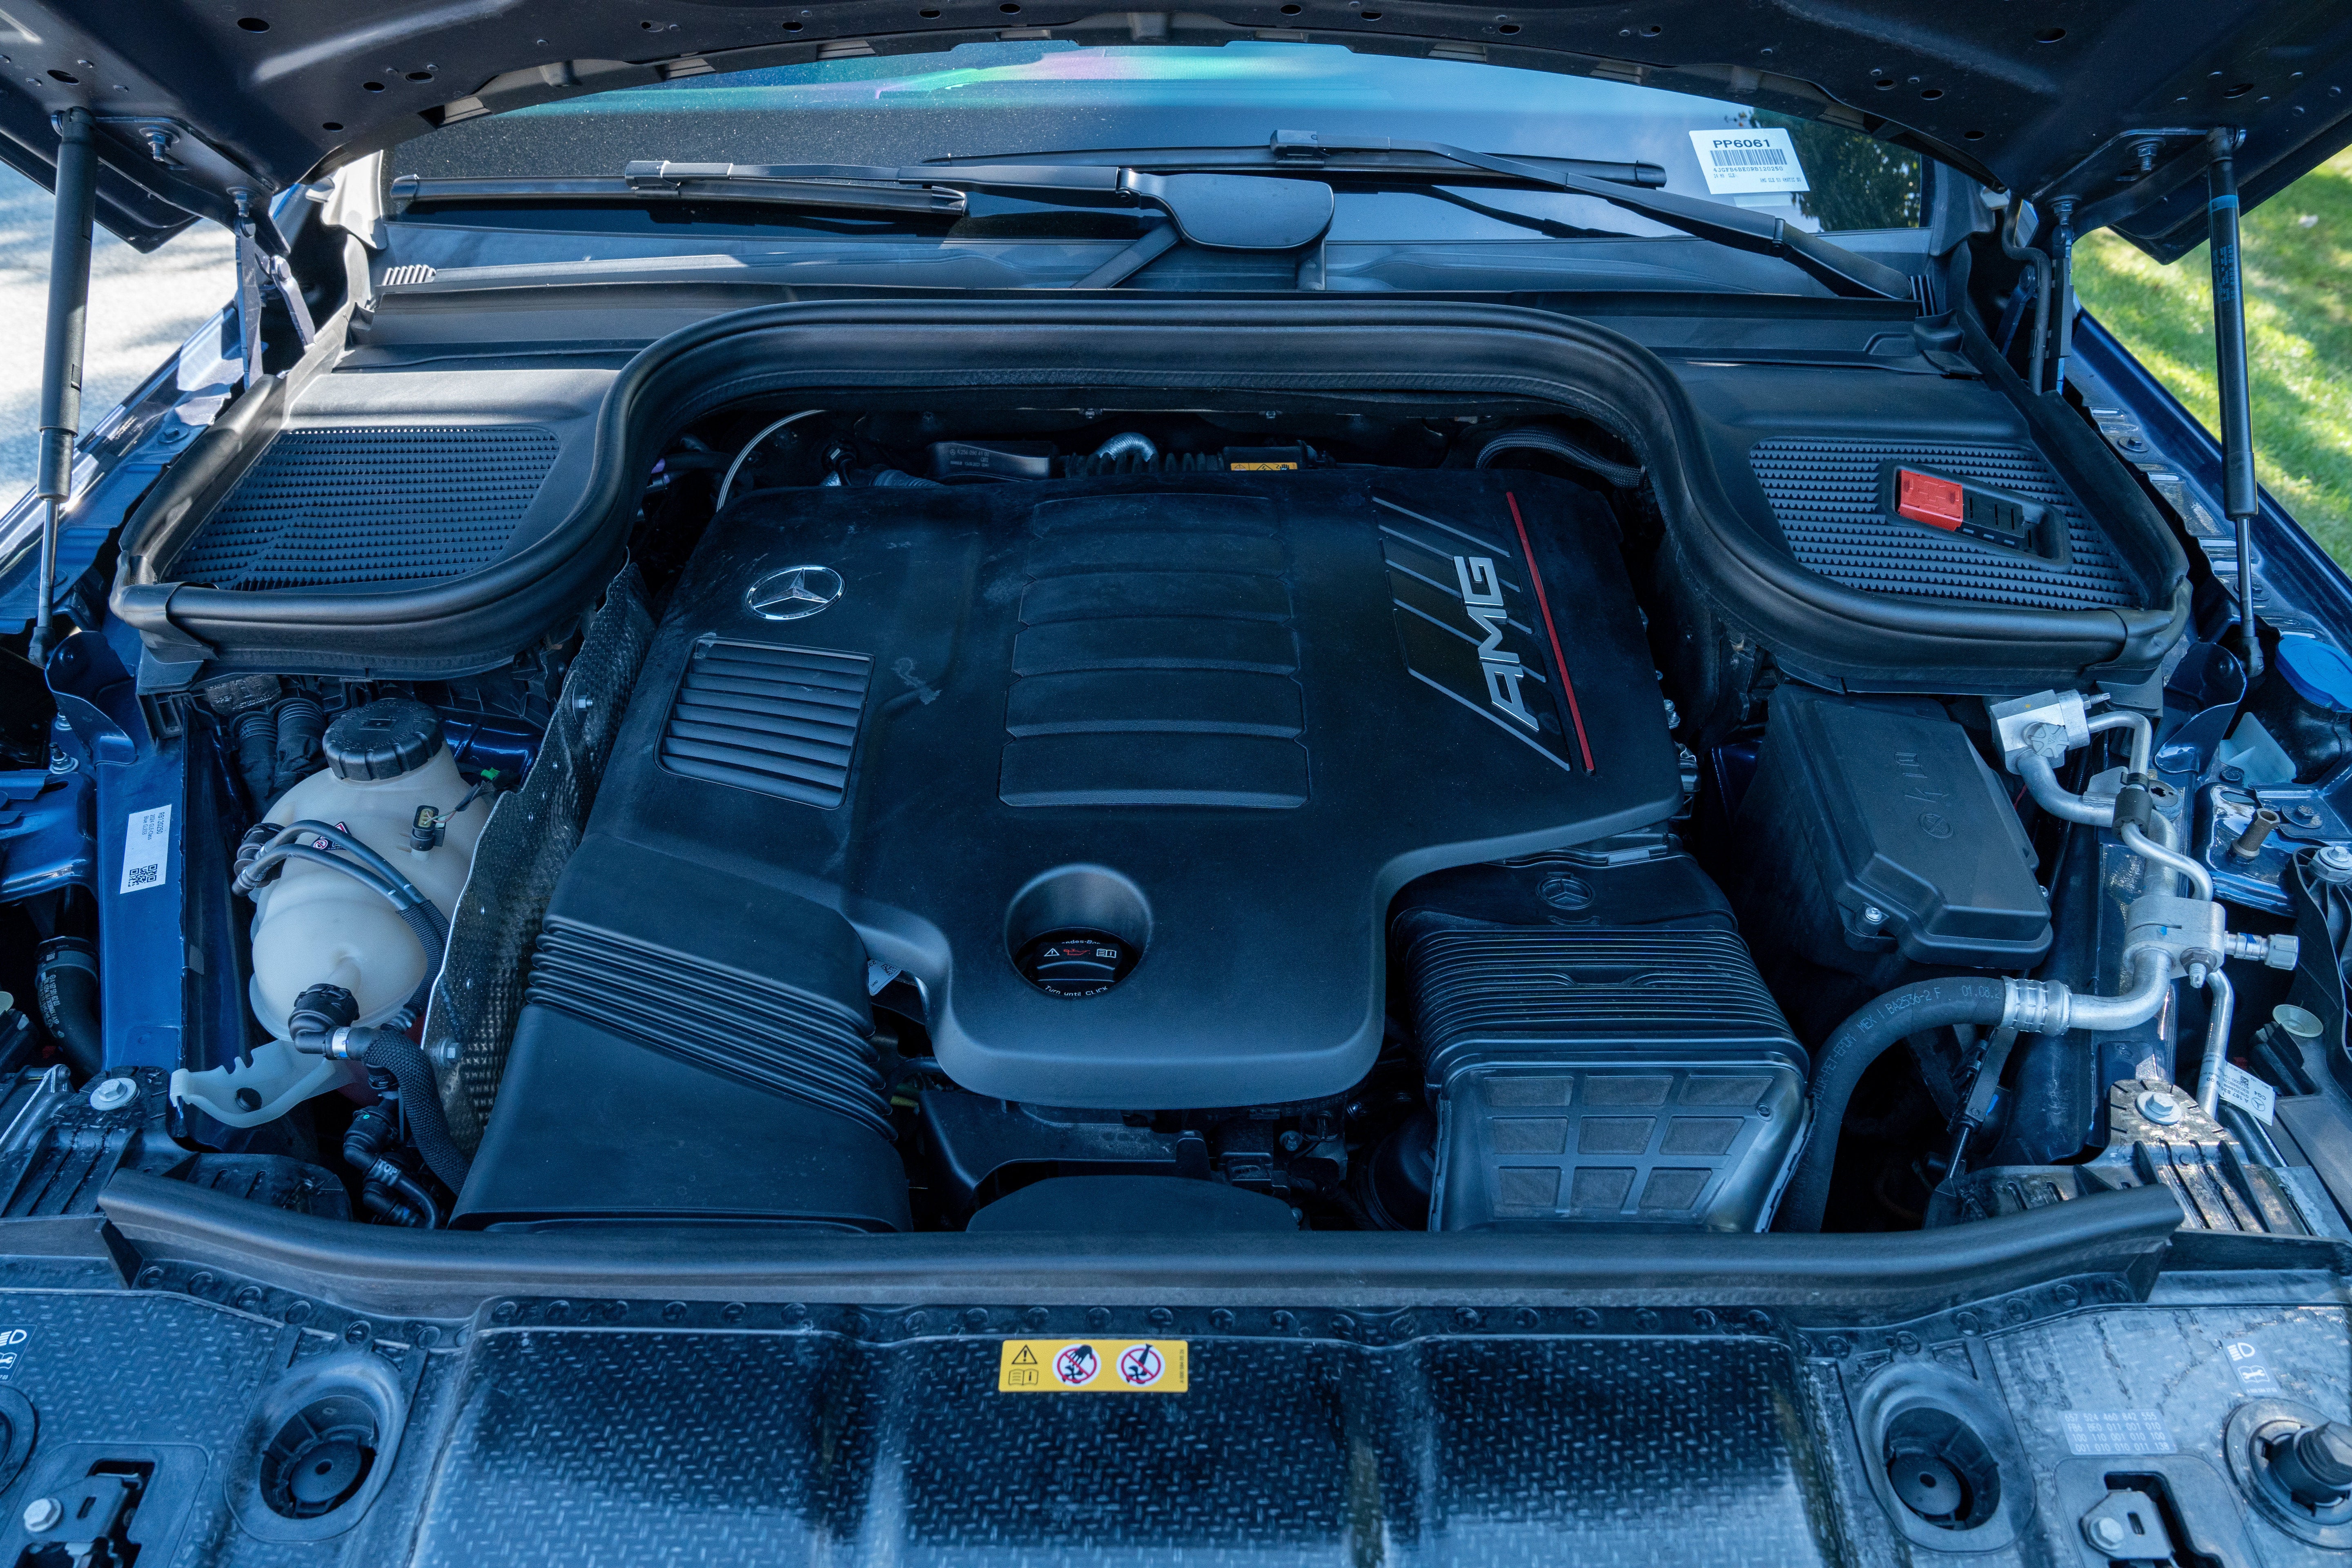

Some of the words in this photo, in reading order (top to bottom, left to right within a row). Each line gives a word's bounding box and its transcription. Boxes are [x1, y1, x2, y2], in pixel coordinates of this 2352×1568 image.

[1713, 139, 1771, 148] PP6061
[1453, 556, 1539, 732] AMG
[1045, 985, 1061, 995] Turn
[1085, 986, 1108, 996] CLICK
[1857, 1015, 1877, 1033] MEX
[1885, 990, 1932, 1014] BA2536-2
[1934, 987, 1940, 999] F
[2254, 1091, 2266, 1100] CG4
[378, 1158, 399, 1176] TOP
[2122, 1412, 2138, 1421] 842
[2141, 1412, 2157, 1420] 555
[2125, 1423, 2140, 1431] 001
[2145, 1422, 2161, 1430] 010
[2072, 1434, 2087, 1442] 100
[2092, 1433, 2107, 1441] 110
[2110, 1433, 2125, 1441] 001
[2130, 1432, 2145, 1441] 010
[2150, 1432, 2165, 1440] 100
[2075, 1444, 2090, 1452] 001
[2095, 1443, 2110, 1452] 010
[2114, 1443, 2130, 1452] 010
[2134, 1443, 2149, 1451] 011
